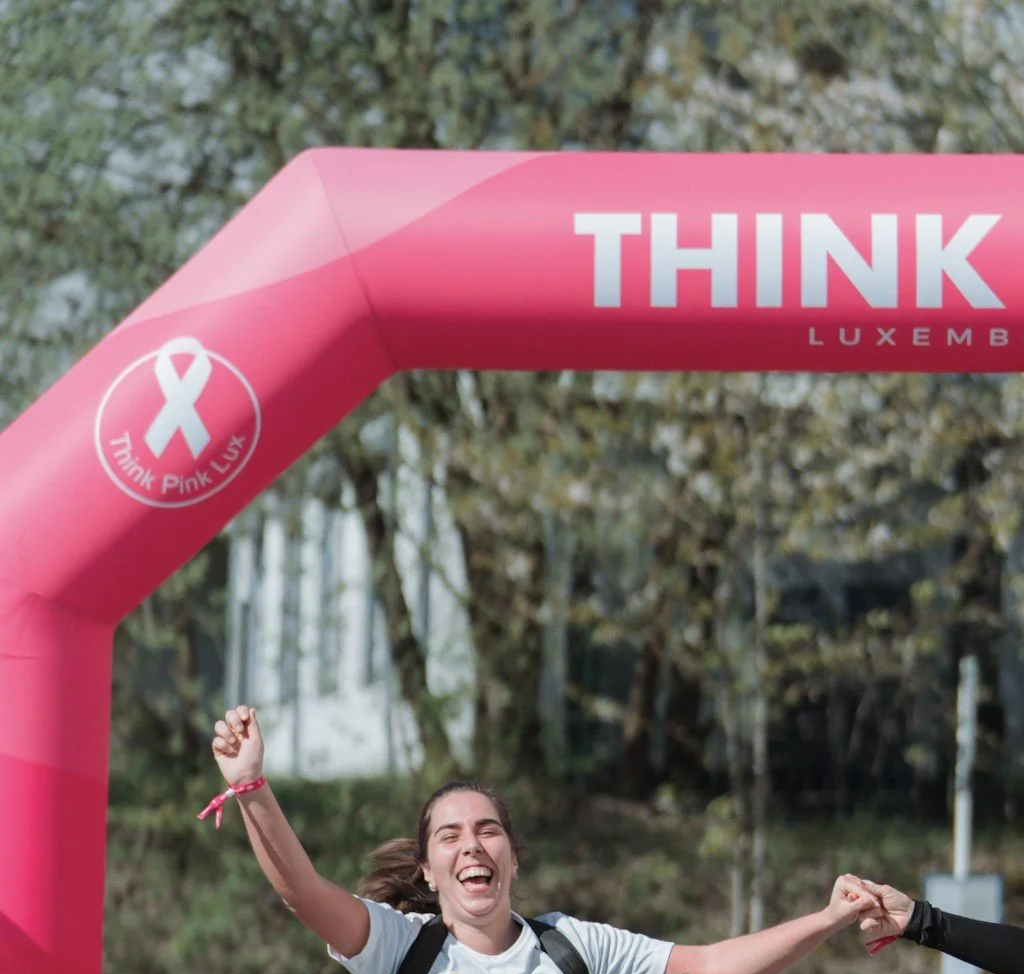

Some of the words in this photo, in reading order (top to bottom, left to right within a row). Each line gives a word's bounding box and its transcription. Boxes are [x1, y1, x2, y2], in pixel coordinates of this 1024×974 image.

[573, 212, 1006, 309] THINK
[110, 431, 155, 490] Think
[161, 471, 212, 494] Pink
[210, 435, 245, 474] Lux
